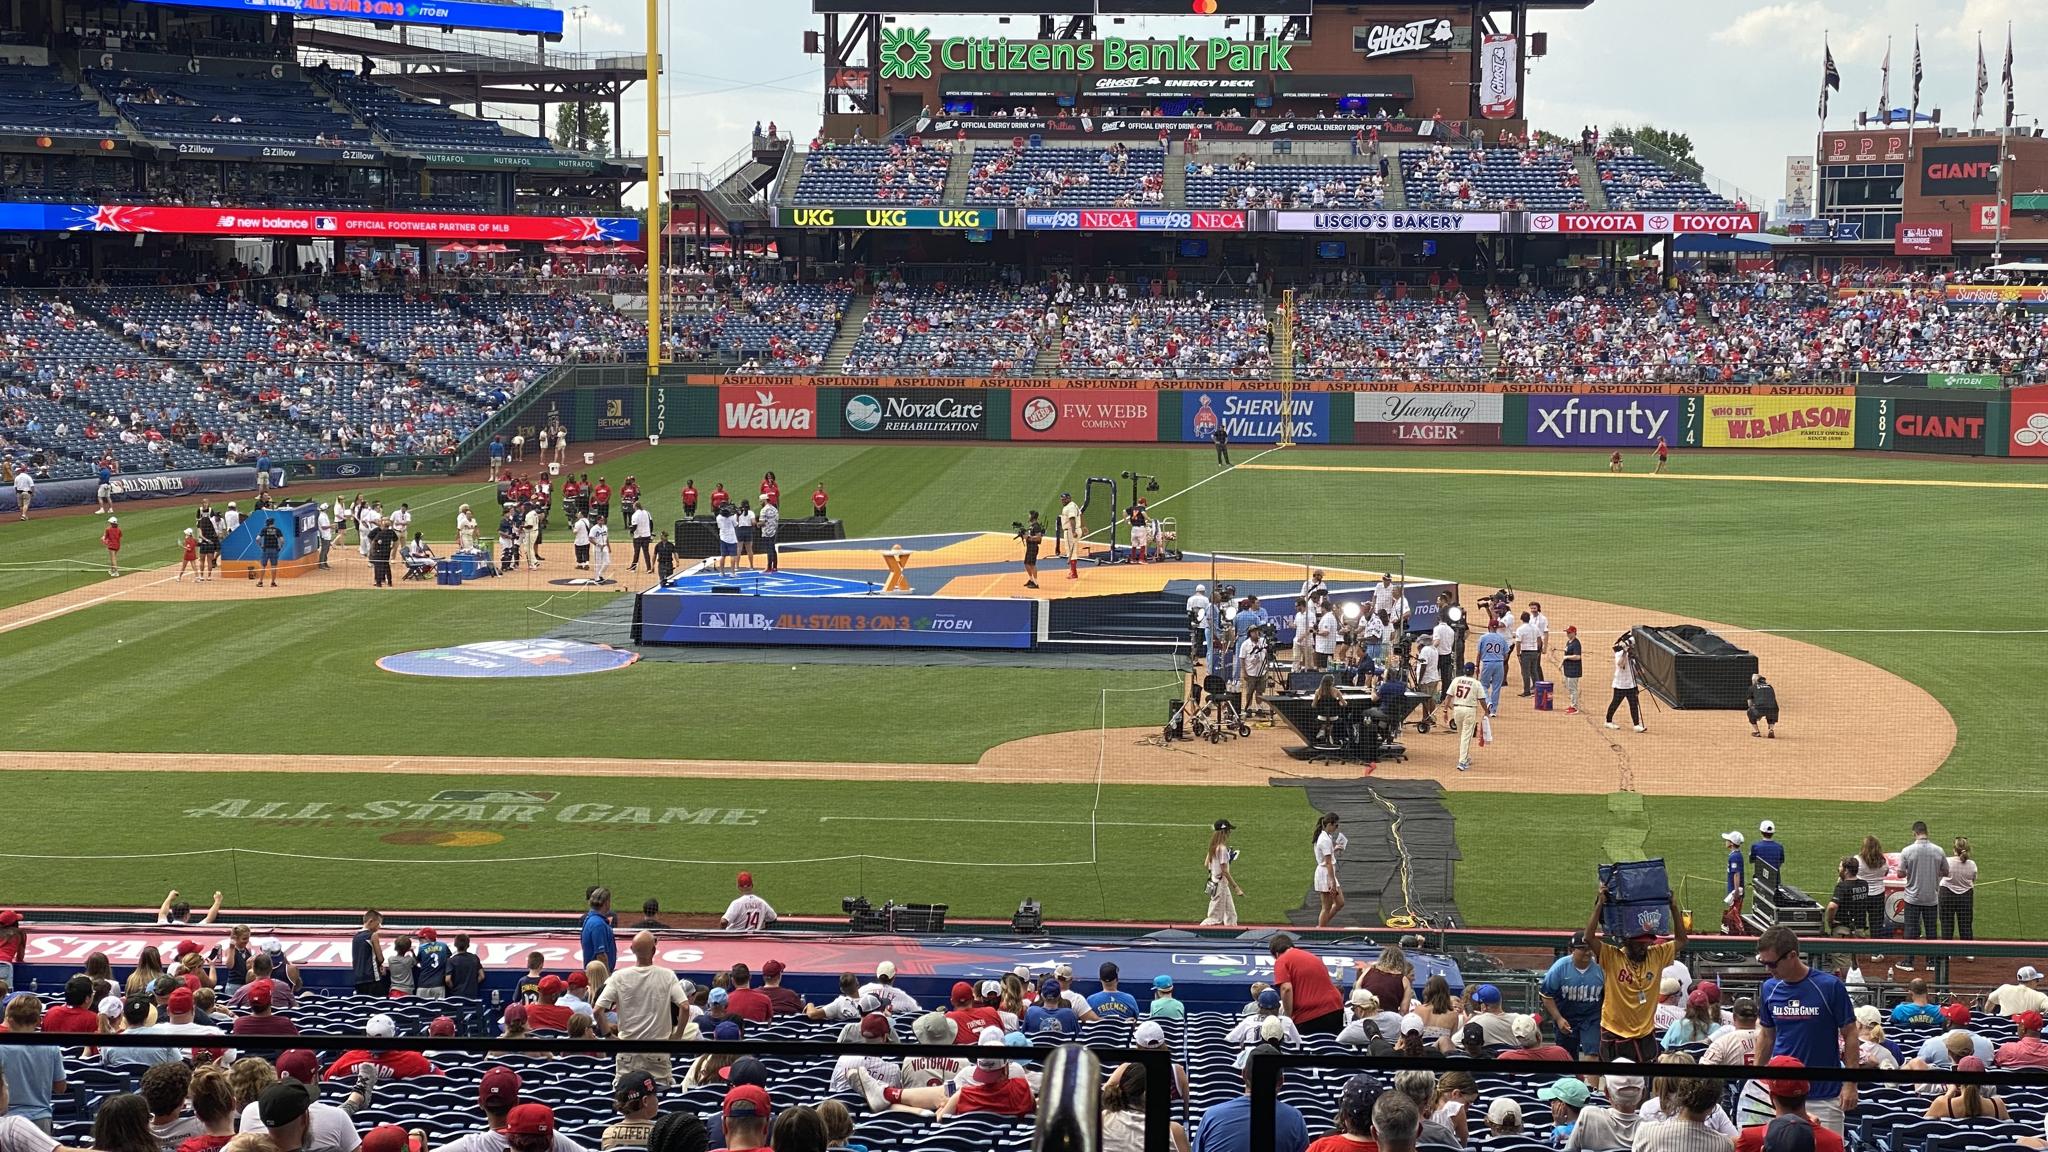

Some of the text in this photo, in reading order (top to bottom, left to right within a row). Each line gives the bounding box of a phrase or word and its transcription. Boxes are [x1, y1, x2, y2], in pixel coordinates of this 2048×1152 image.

[1366, 19, 1437, 58] GHOST
[941, 35, 1293, 70] Citizens Bank Park
[1095, 77, 1149, 89] GHOST
[1047, 120, 1076, 130] Phillies
[1215, 120, 1243, 131] Phillies
[188, 145, 214, 154] Zillow
[271, 148, 296, 157] Zillow
[350, 151, 374, 160] Zillow
[426, 155, 465, 163] NUTRAFOL
[494, 157, 531, 166] NUTRAFOL
[558, 160, 595, 168] NUTRAFOL
[1928, 162, 1991, 180] GIANT
[237, 218, 260, 228] new
[262, 217, 308, 228] balance
[793, 209, 834, 226] UKG
[866, 210, 907, 226] UKG
[939, 210, 979, 227] UKG
[1085, 212, 1135, 228] NECA
[1197, 212, 1245, 228] NECA
[1315, 215, 1464, 229] LISCIO'S BAKERY
[1566, 216, 1636, 229] TOYOTA
[345, 221, 510, 232] OFFICIAL FOOTWEAR PARTNER OF MLB
[1681, 217, 1752, 230] TOYOTA
[1956, 287, 1998, 302] Surfside
[722, 376, 794, 385] ASPLUNDH
[808, 378, 880, 386] ASPLUNDH
[894, 378, 966, 387] ASPLUNDH
[980, 380, 1052, 388] ASPLUNDH
[1066, 380, 1138, 389] ASPLUNDH
[1152, 381, 1224, 390] ASPLUNDH
[1326, 383, 1398, 392] ASPLUNDH
[1413, 384, 1486, 392] ASPLUNDH
[1500, 385, 1573, 394] ASPLUNDH
[1588, 385, 1662, 394] ASPLUNDH
[1678, 386, 1752, 394] ASPLUNDH
[1770, 386, 1844, 395] ASPLUNDH
[884, 397, 982, 418] NovaCare
[1063, 404, 1148, 418] F.W. WEBB
[1223, 396, 1314, 416] SHERWIN
[1382, 396, 1476, 422] Yuengling
[1712, 407, 1754, 416] WHO BUT
[724, 402, 810, 430] Wawa
[1536, 398, 1670, 439] xfinity
[598, 418, 631, 426] BETMGM
[885, 422, 978, 431] REHABILITATION
[1081, 419, 1128, 428] COMPANY
[1895, 414, 1984, 440] GIANT
[1398, 425, 1457, 440] LAGER
[160, 478, 182, 490] WEEK
[1414, 606, 1428, 615] ITO
[932, 619, 973, 630] ITO EN
[1486, 643, 1501, 654] 20
[1456, 686, 1472, 699] 57
[182, 798, 768, 825] ALL STAR GAME
[1852, 886, 1866, 894] FIELD
[745, 912, 760, 928] 14
[430, 952, 438, 968] 3
[1618, 968, 1633, 984] 64
[1772, 1006, 1819, 1016] ALL STAR GAME
[1908, 1014, 1934, 1024] HARPER
[912, 1057, 960, 1073] VICTORINO
